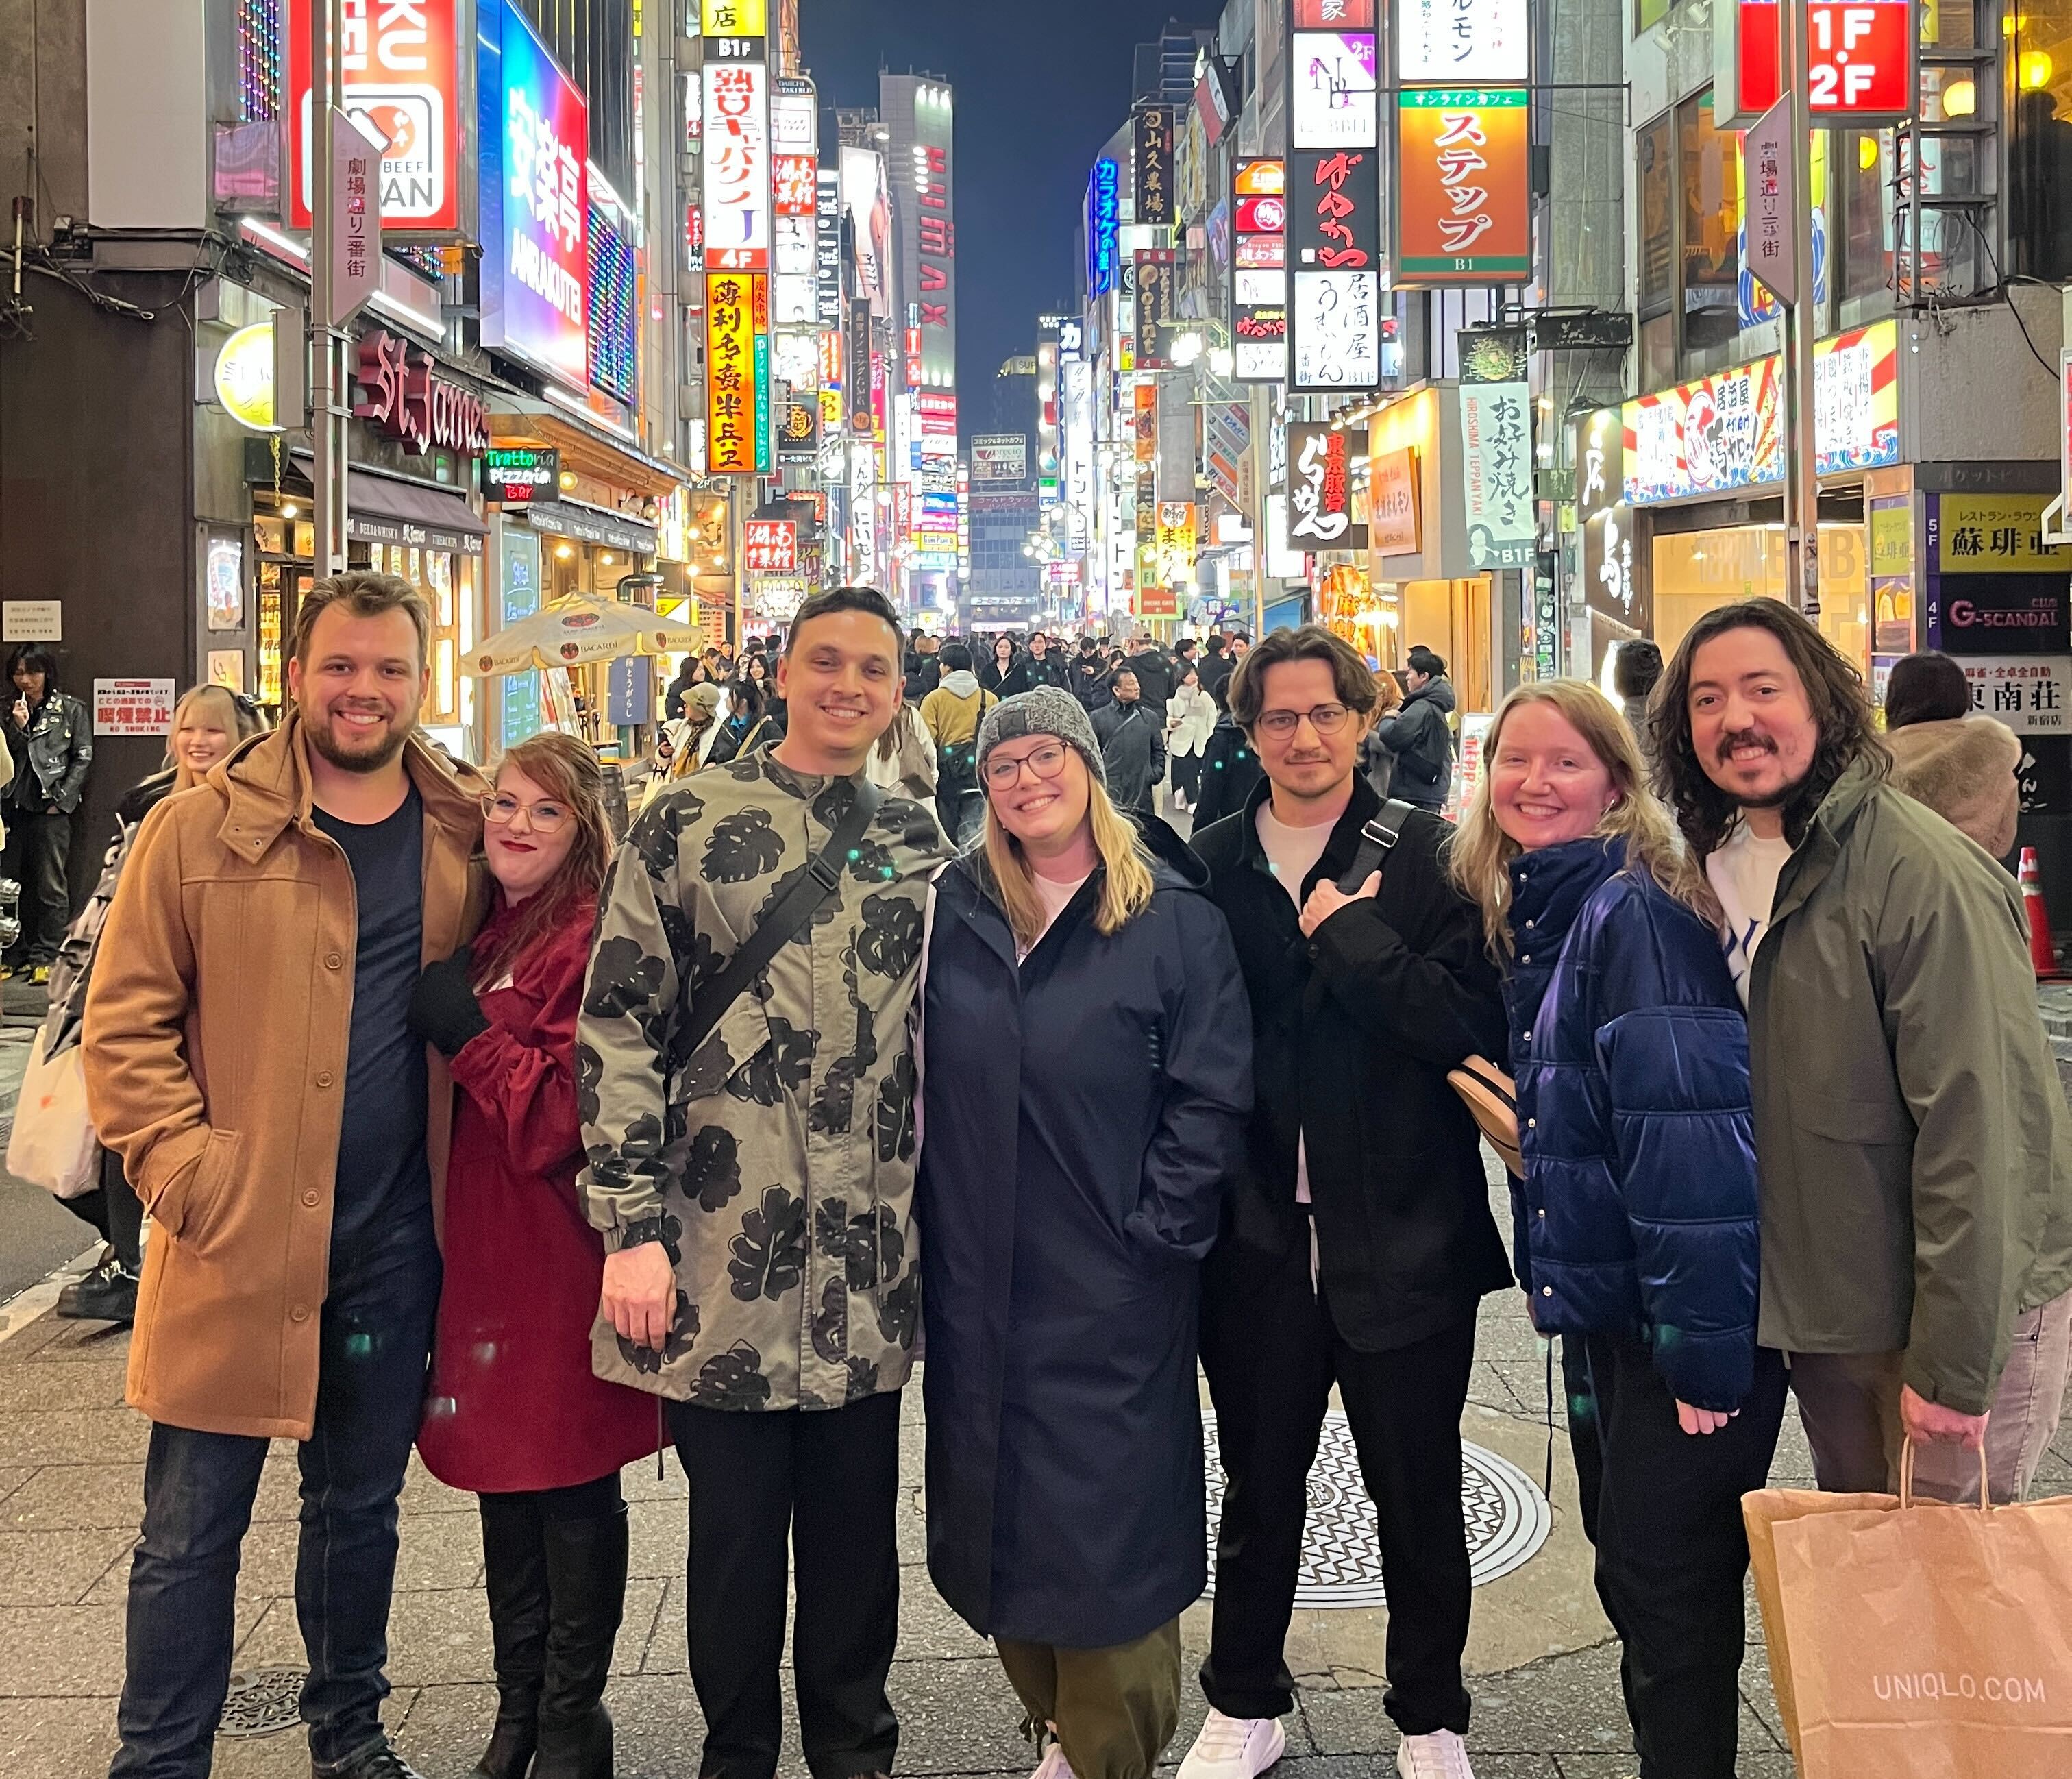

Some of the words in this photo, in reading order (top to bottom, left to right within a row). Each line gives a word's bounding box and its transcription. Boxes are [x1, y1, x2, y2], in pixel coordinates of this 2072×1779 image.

[712, 5, 737, 29] 店
[1812, 10, 1875, 50] 1F
[718, 38, 751, 57] B1F
[1352, 41, 1373, 61] 2F
[1810, 64, 1875, 104] 2F
[1414, 93, 1513, 106] オンラインカフェ
[384, 162, 423, 173] BEEF
[509, 87, 580, 253] 安楽亭
[1435, 114, 1492, 253] ステップ
[1759, 141, 1779, 258] 劇場通り一番街
[347, 158, 366, 278] 劇場通り一番街
[720, 249, 752, 268] 4F
[1454, 258, 1473, 271] B1
[1344, 273, 1371, 360] 居酒屋
[1466, 397, 1480, 450] HIROSHIMA
[487, 450, 554, 467] Trattoria
[1485, 395, 1529, 526] お好み焼き
[489, 467, 551, 485] Pizzeria
[1324, 433, 1346, 512] 東京豚骨
[506, 484, 534, 500] Bar
[1470, 455, 1483, 516] TEPPANYAKI
[1960, 511, 2041, 522] レストラン・ラウン
[1501, 548, 1535, 563] B1F
[1949, 600, 2058, 628] G-SCANDAL
[1965, 667, 2051, 678] 麻雀・全卓全自動
[1969, 680, 2062, 712] 東南荘
[98, 707, 171, 724] 喫煙禁止
[2027, 715, 2061, 726] 新宿店
[1873, 1673, 2045, 1704] UNIQLO.COM
